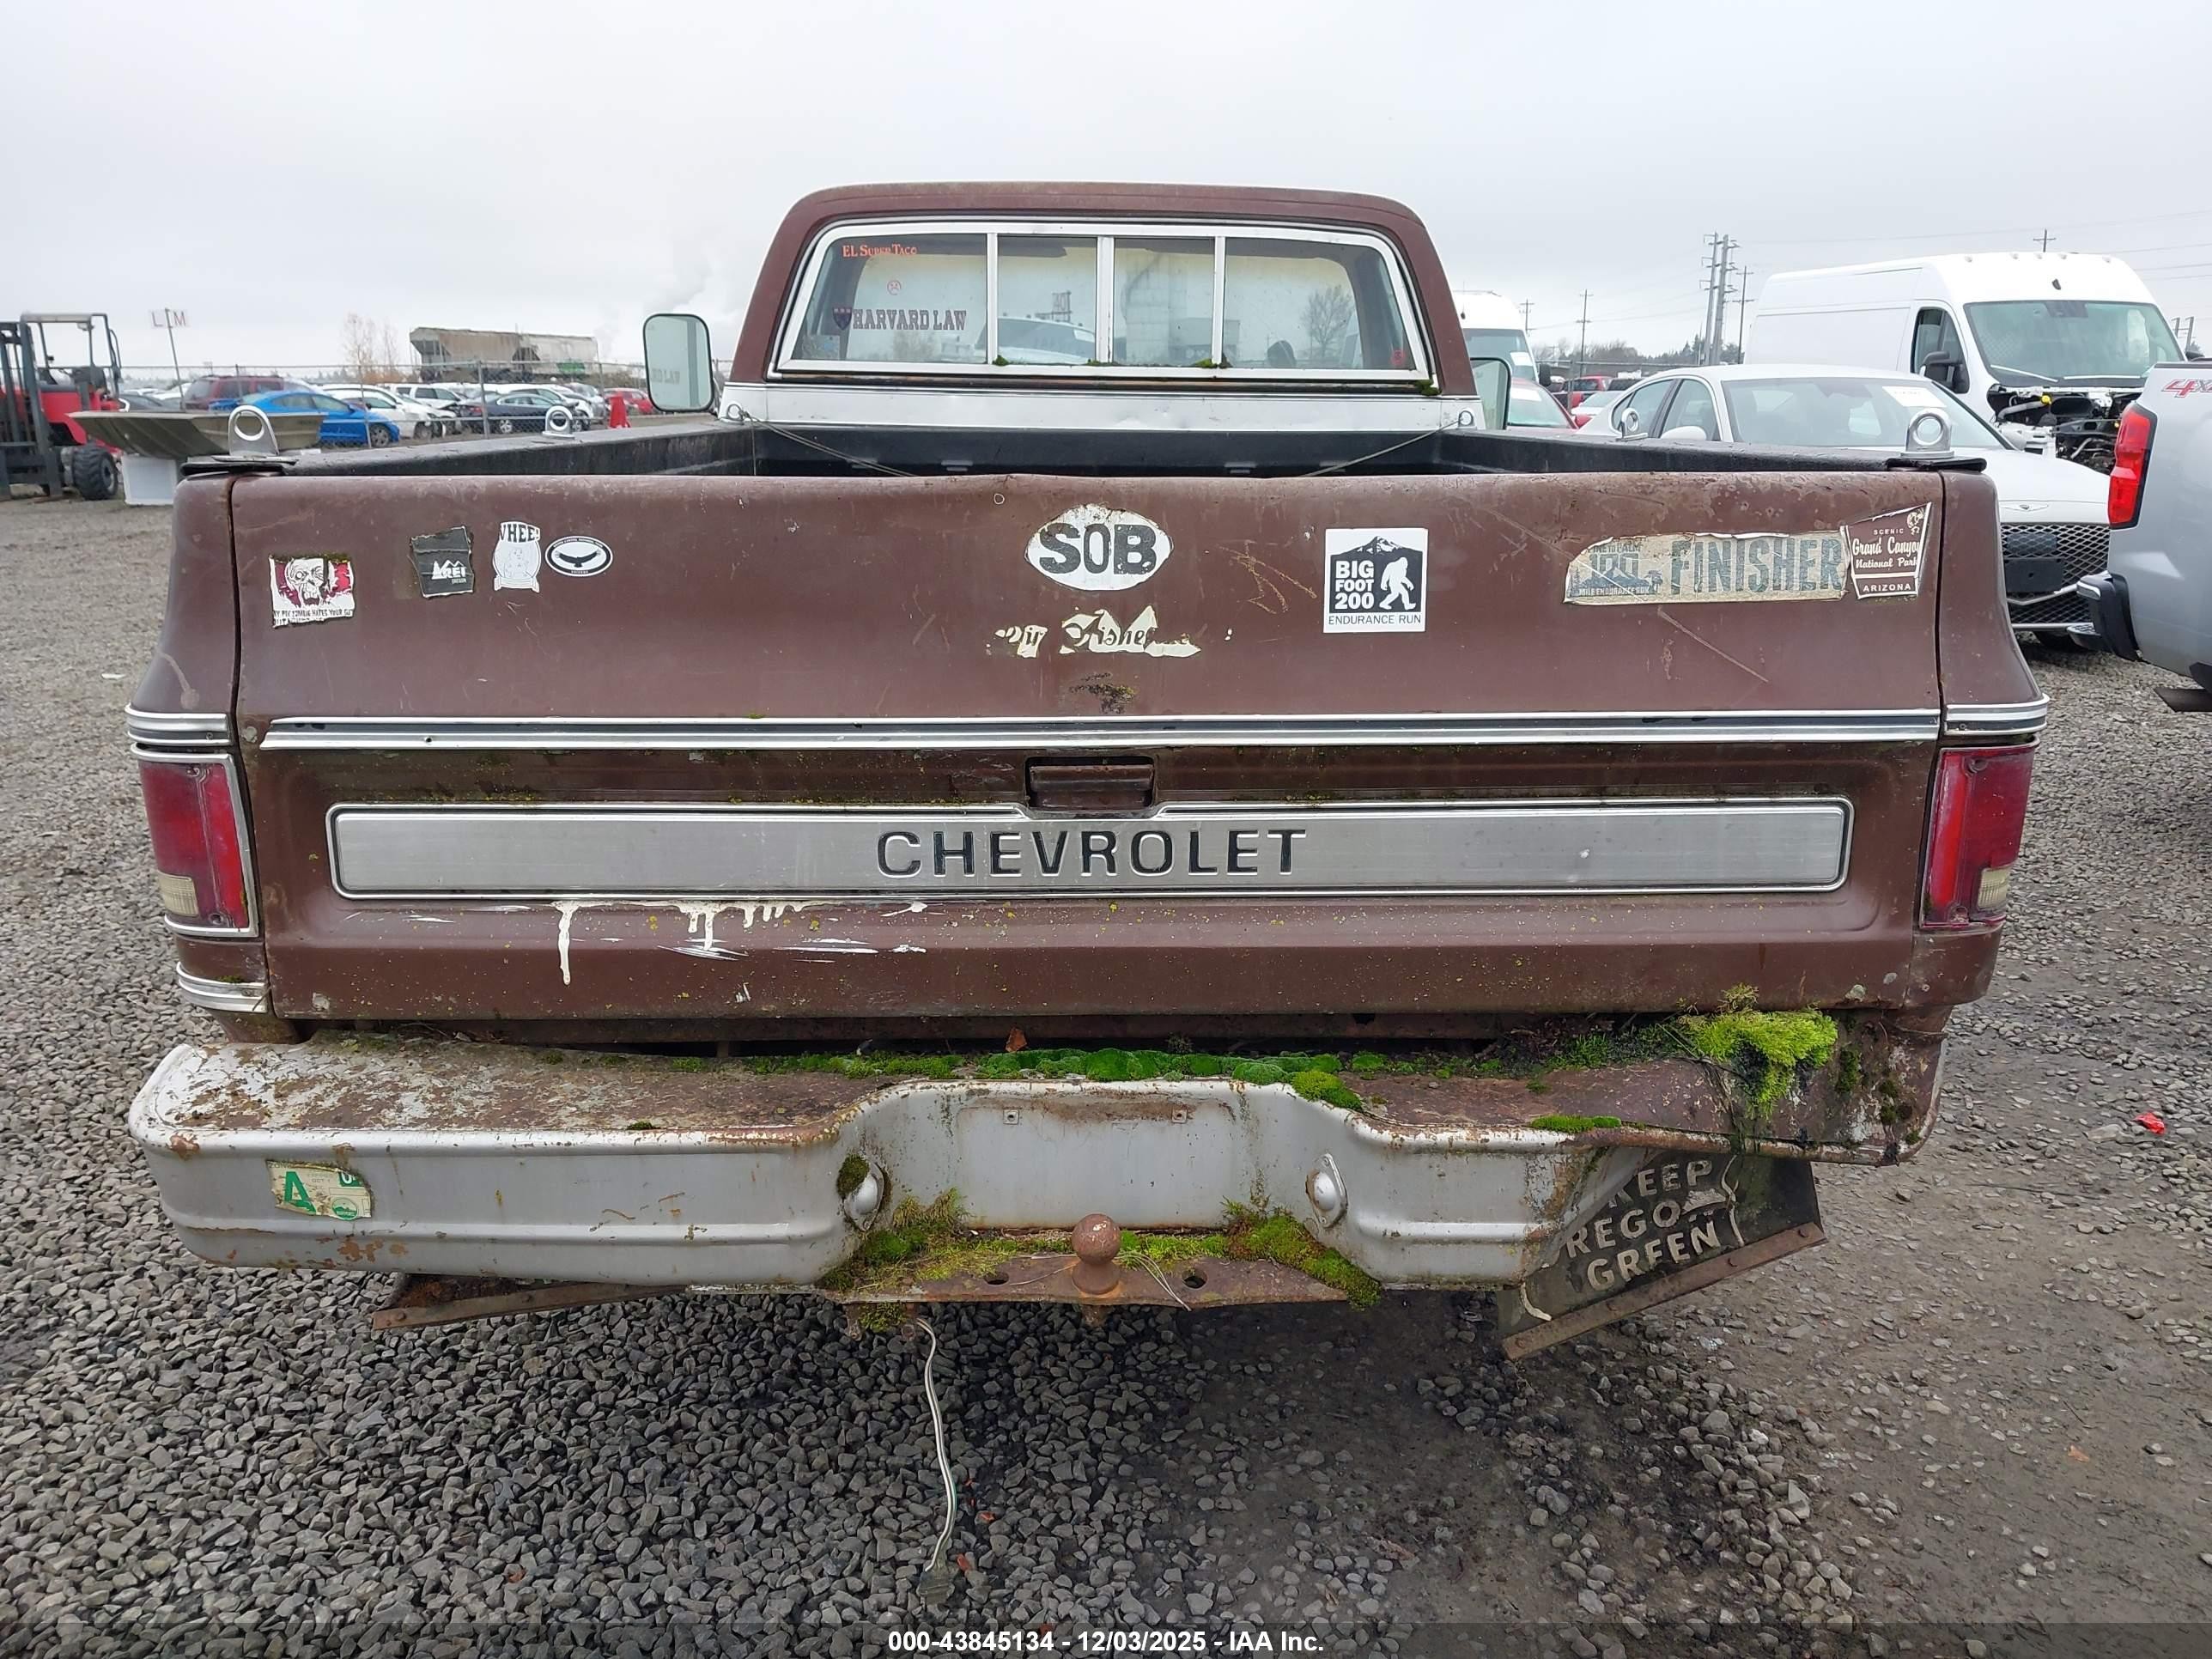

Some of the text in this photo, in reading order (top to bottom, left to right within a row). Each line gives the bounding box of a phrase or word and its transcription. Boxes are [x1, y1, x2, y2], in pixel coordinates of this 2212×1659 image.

[842, 245, 858, 258] EL
[853, 308, 967, 331] HARVARD LAW
[2160, 378, 2212, 398] 4X
[1038, 522, 1158, 574] SOB
[1852, 537, 1883, 556] Grand
[1335, 560, 1375, 579] BIG
[1670, 538, 1843, 595] FINISHER
[1856, 558, 1893, 569] National
[1335, 579, 1375, 592] FOOT
[1863, 583, 1911, 592] ARIZONA
[1334, 592, 1375, 610] 200
[1328, 614, 1421, 625] ENDURANCE RUN
[877, 830, 1307, 878] CHEVROLET
[283, 1170, 317, 1214] A
[1587, 1220, 1721, 1290] GREEN
